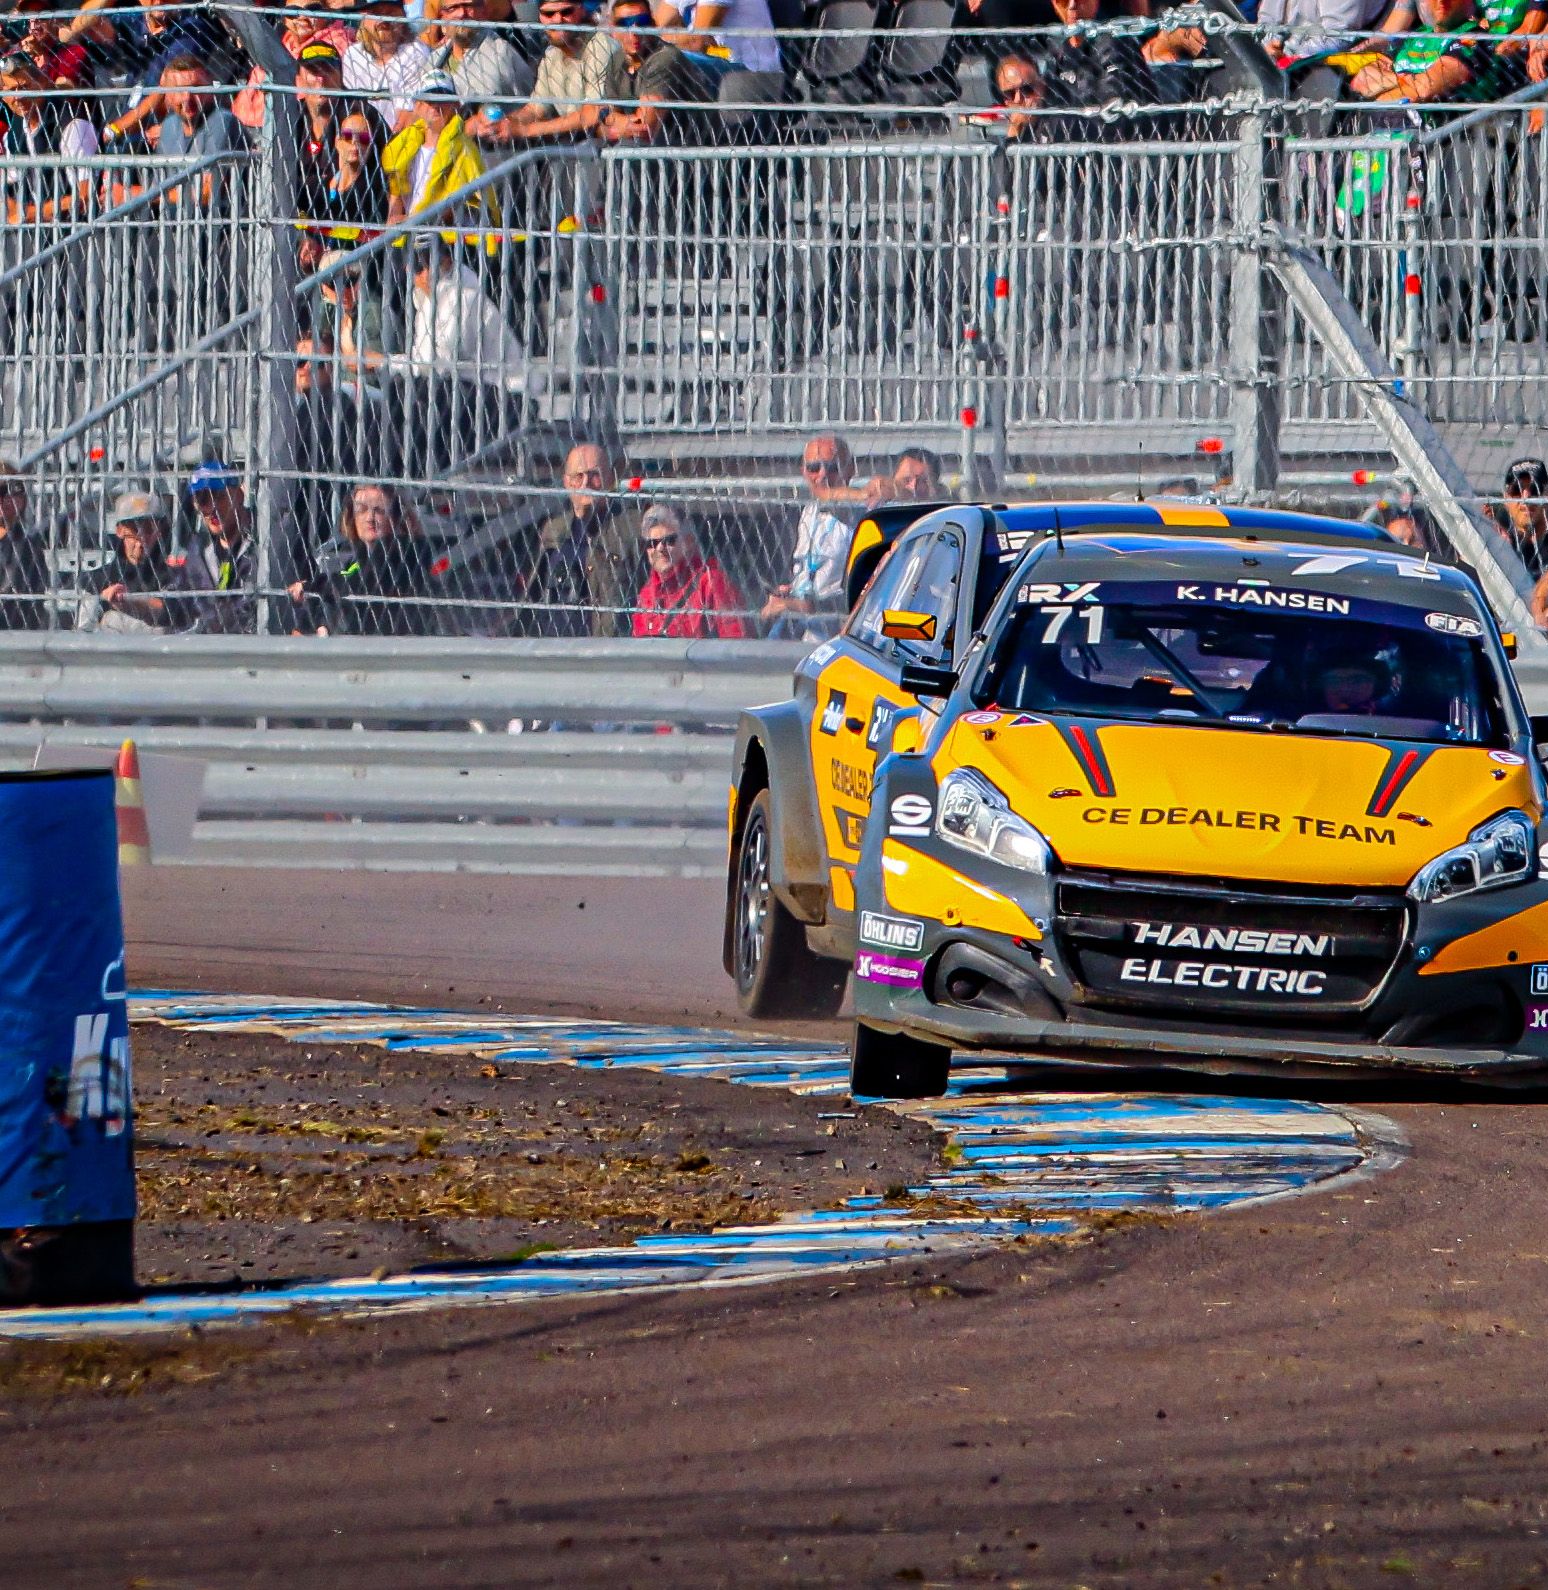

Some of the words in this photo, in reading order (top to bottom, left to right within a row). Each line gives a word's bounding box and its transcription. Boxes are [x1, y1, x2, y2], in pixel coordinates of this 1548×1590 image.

[1287, 553, 1442, 581] 71
[1176, 585, 1205, 600] K.
[1214, 588, 1350, 615] HANSEN
[1040, 605, 1104, 644] 71
[1429, 615, 1480, 634] FIA
[1082, 807, 1132, 825] CE
[1139, 807, 1281, 832] DEALER
[1292, 815, 1396, 845] TEAM
[863, 914, 918, 946] ÖHLINS
[1131, 922, 1329, 957] HANSEN
[1121, 958, 1327, 995] ELECTRIC
